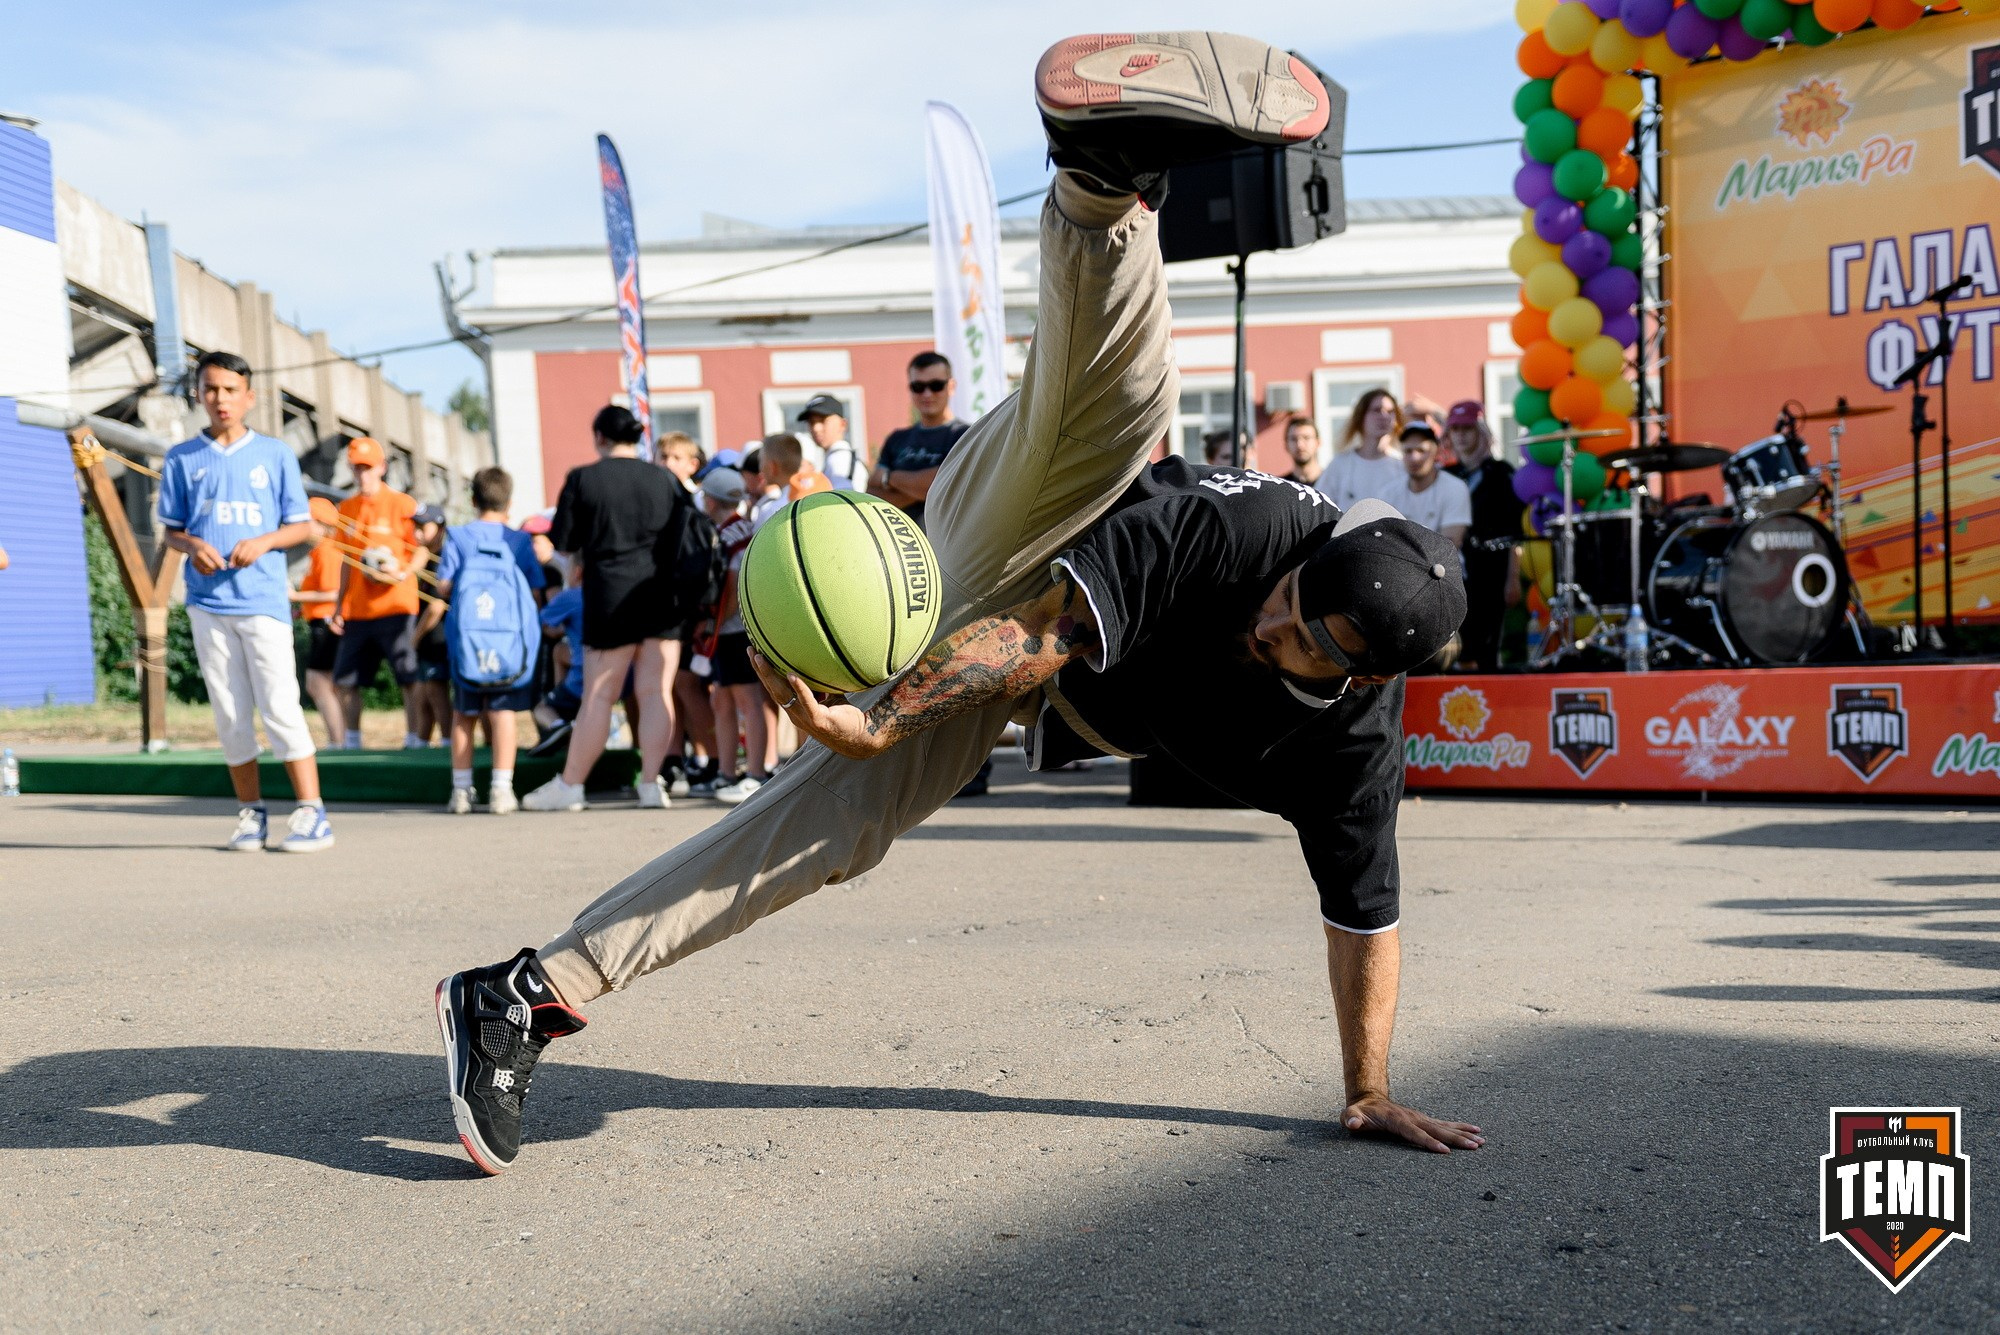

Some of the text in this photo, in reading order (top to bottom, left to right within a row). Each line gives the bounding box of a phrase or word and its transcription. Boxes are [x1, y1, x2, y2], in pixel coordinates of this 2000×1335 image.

[1127, 53, 1160, 67] NIKE
[1971, 89, 2000, 146] Т
[1829, 224, 2000, 316] ГАЛА
[216, 500, 263, 527] ВТБ
[880, 506, 928, 616] TACHIKARA
[1555, 713, 1611, 746] ТЕМП
[1644, 716, 1796, 746] GALAXY
[1834, 711, 1900, 746] ТЕМП
